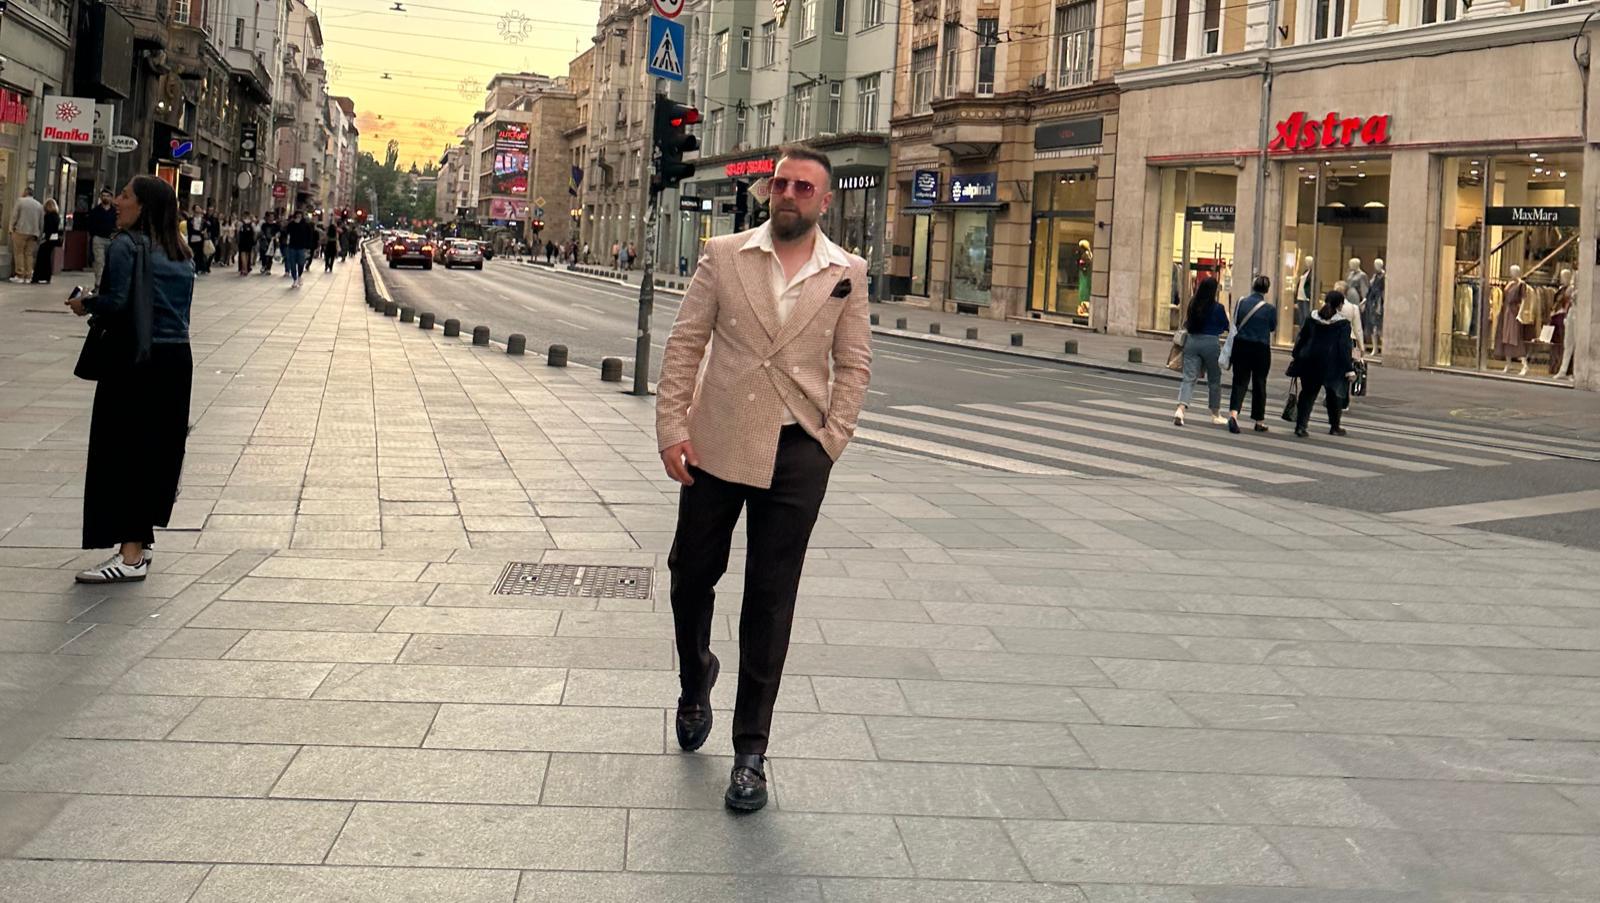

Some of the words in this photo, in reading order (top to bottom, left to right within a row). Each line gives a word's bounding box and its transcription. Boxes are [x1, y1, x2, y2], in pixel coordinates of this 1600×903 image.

[44, 127, 89, 142] Planika
[1268, 111, 1389, 149] Astra
[839, 176, 875, 189] BARBOSA
[962, 183, 991, 199] alpina
[1512, 208, 1558, 221] MaxMara
